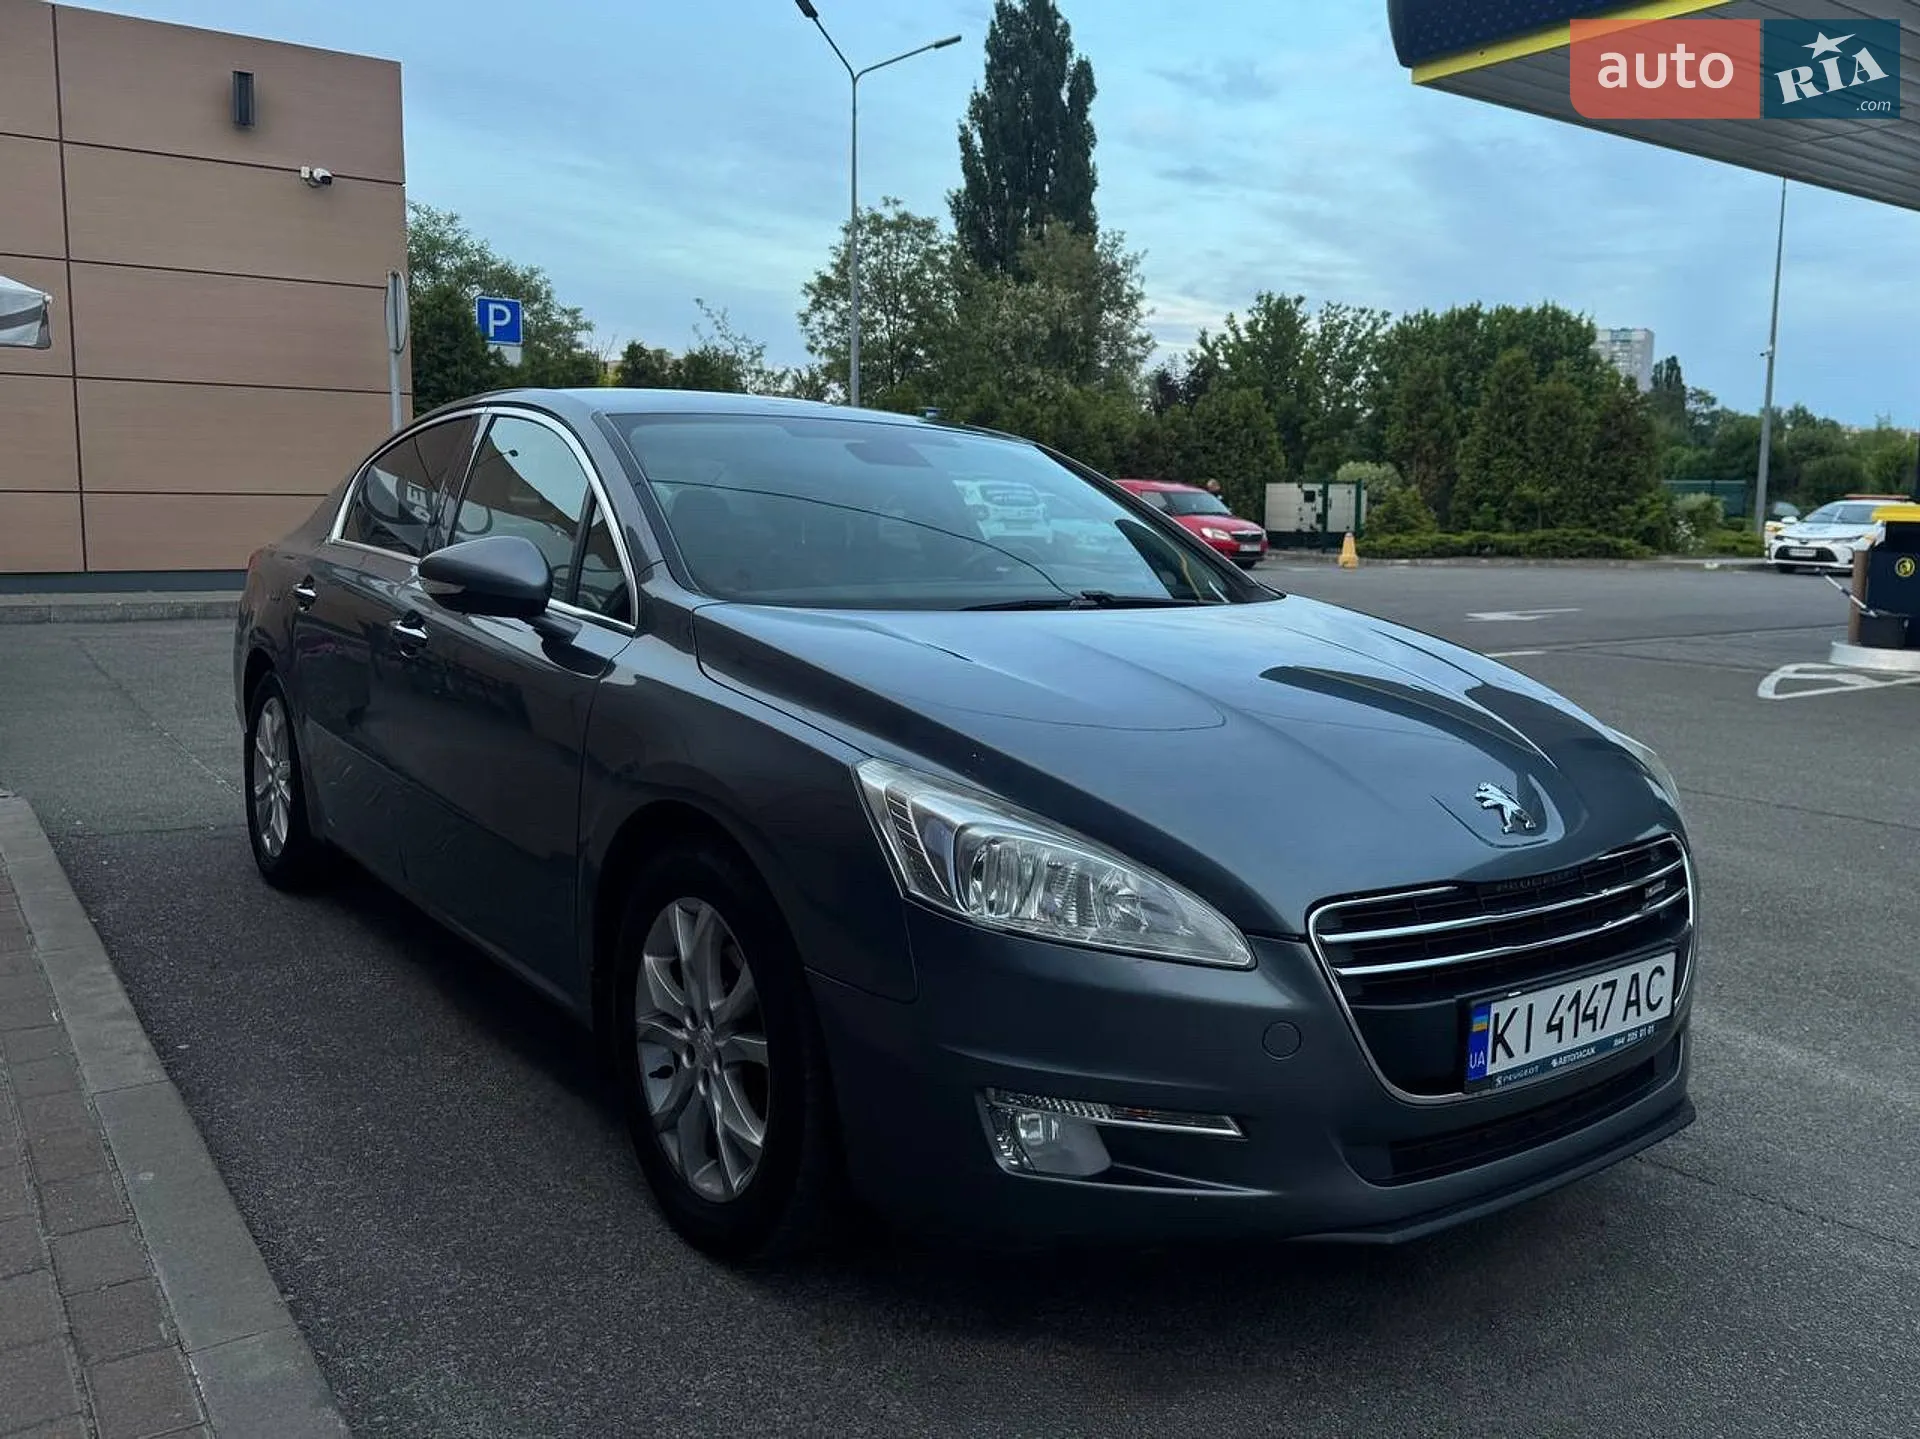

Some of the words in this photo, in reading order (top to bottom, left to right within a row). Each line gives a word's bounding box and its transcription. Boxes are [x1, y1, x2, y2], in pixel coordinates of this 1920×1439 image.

[488, 303, 512, 337] P
[1491, 1002, 1534, 1064] KI
[1546, 978, 1618, 1044] 4147
[1622, 965, 1665, 1022] AC
[1469, 1050, 1486, 1069] UA
